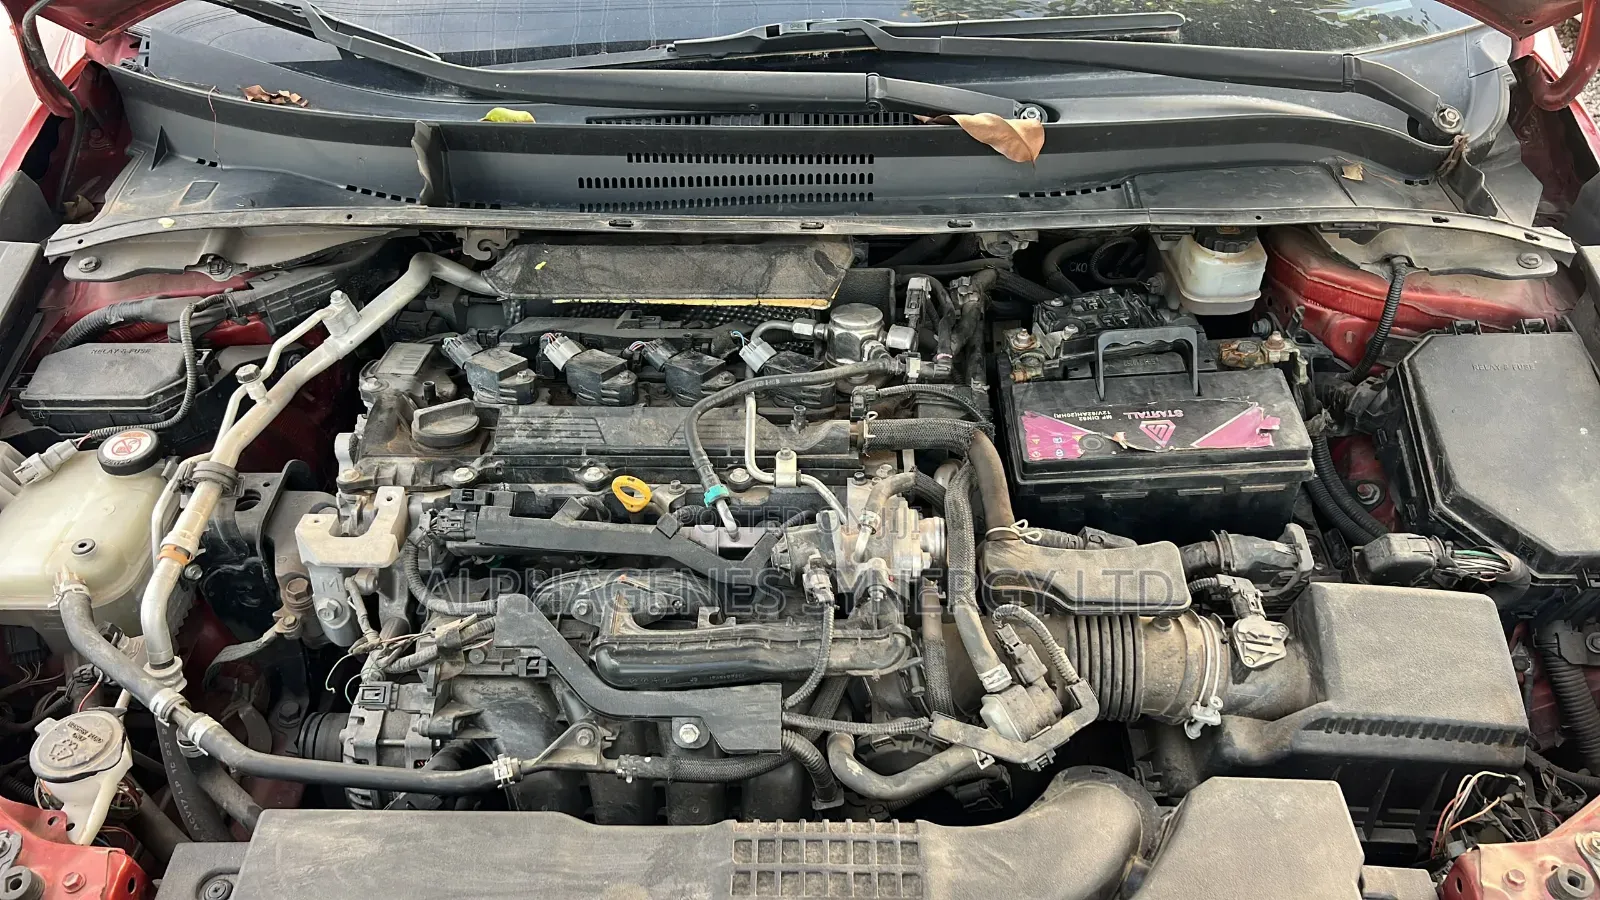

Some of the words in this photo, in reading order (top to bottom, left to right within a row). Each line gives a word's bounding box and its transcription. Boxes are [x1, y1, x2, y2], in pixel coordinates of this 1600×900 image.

[1471, 363, 1500, 371] RELAY
[1511, 363, 1535, 371] FUSE
[1123, 409, 1184, 419] STARTALL
